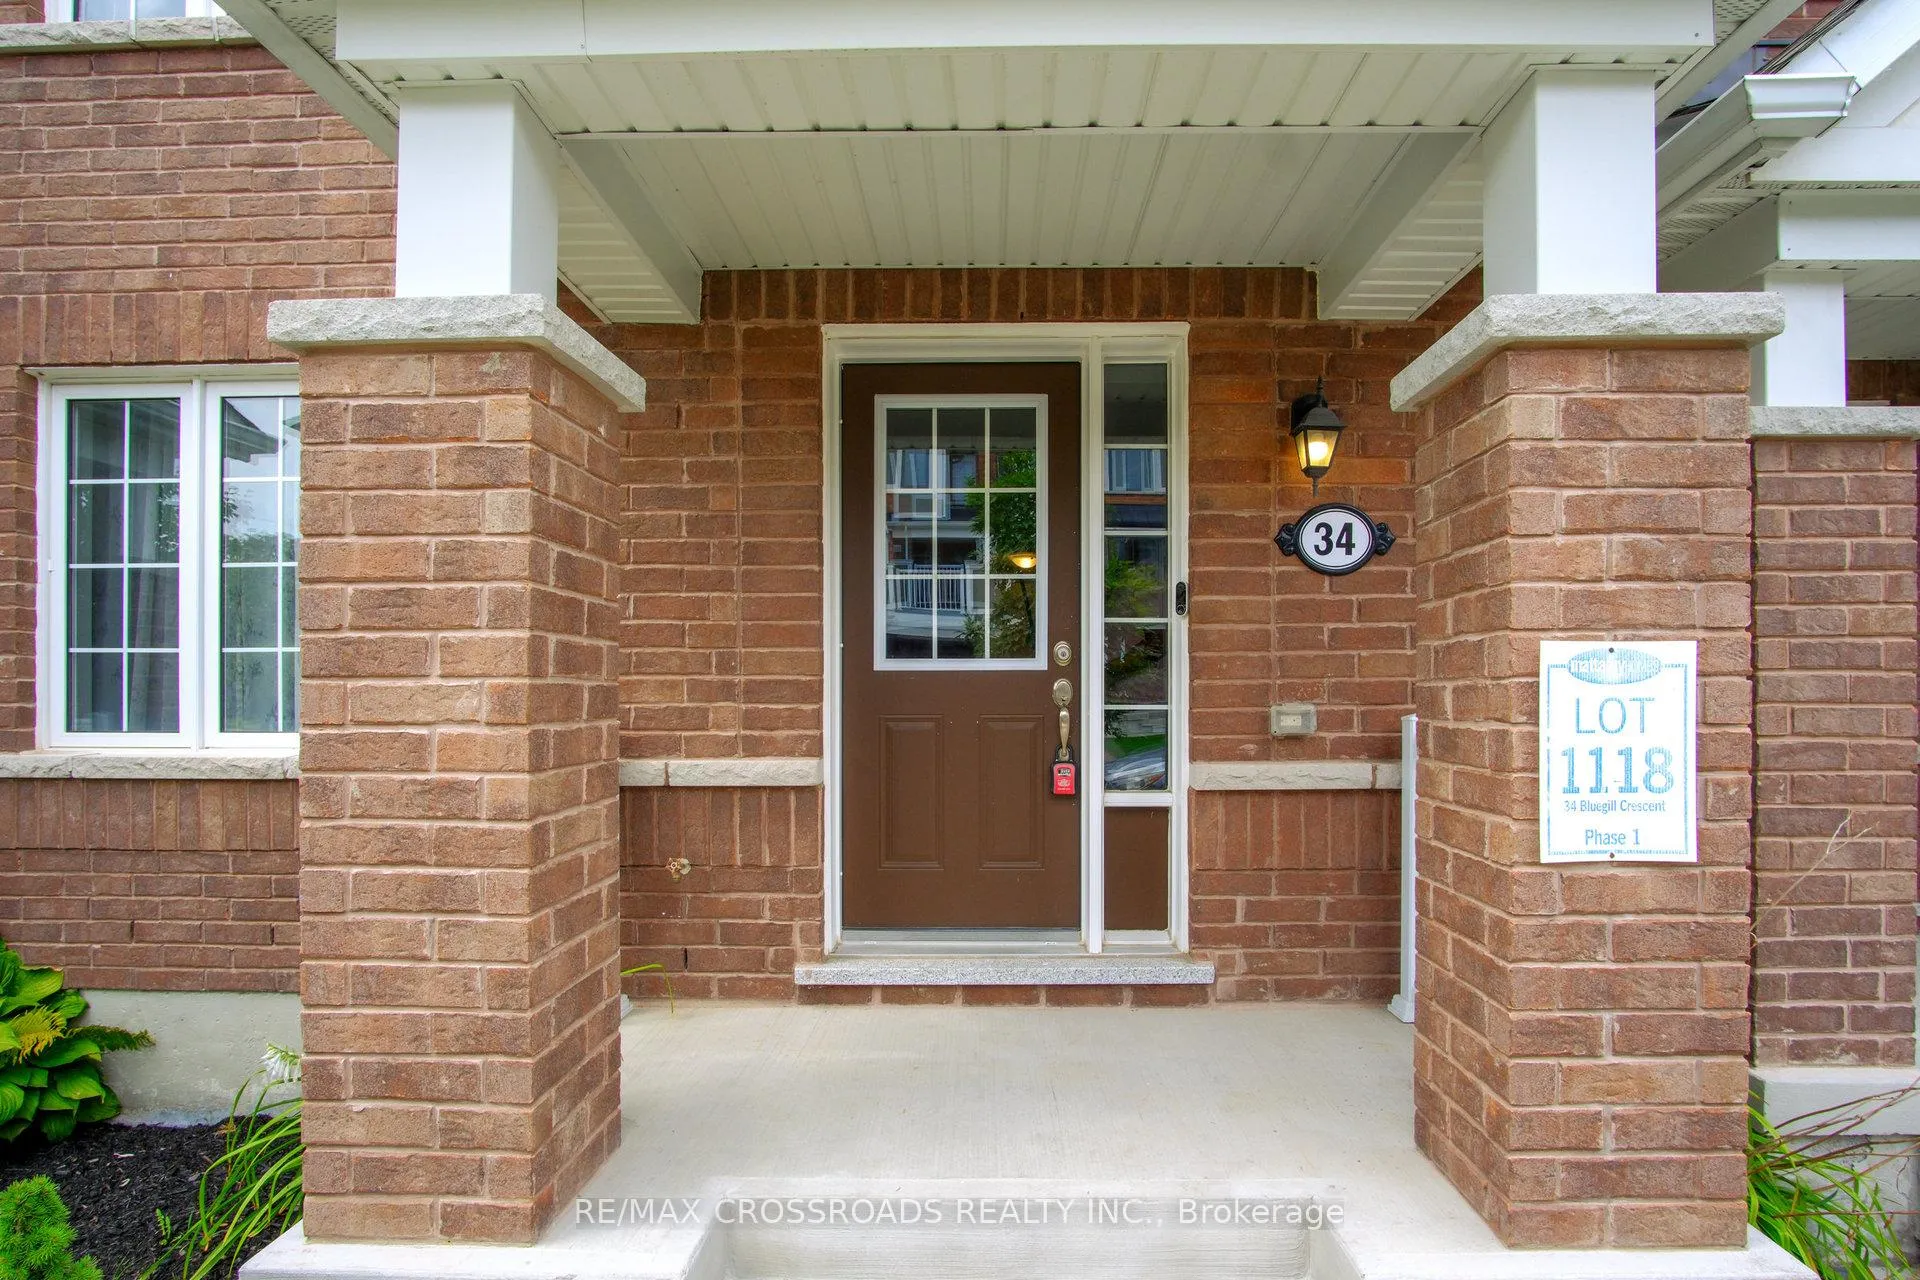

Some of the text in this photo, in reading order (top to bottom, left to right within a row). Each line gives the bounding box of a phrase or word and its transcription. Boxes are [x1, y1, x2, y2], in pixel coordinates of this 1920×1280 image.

[1314, 522, 1356, 556] 34
[1576, 697, 1655, 734] LOT
[1561, 746, 1674, 794] 1118
[1563, 799, 1666, 814] 34 Bluegill Crescent
[1585, 828, 1641, 846] Phase 1
